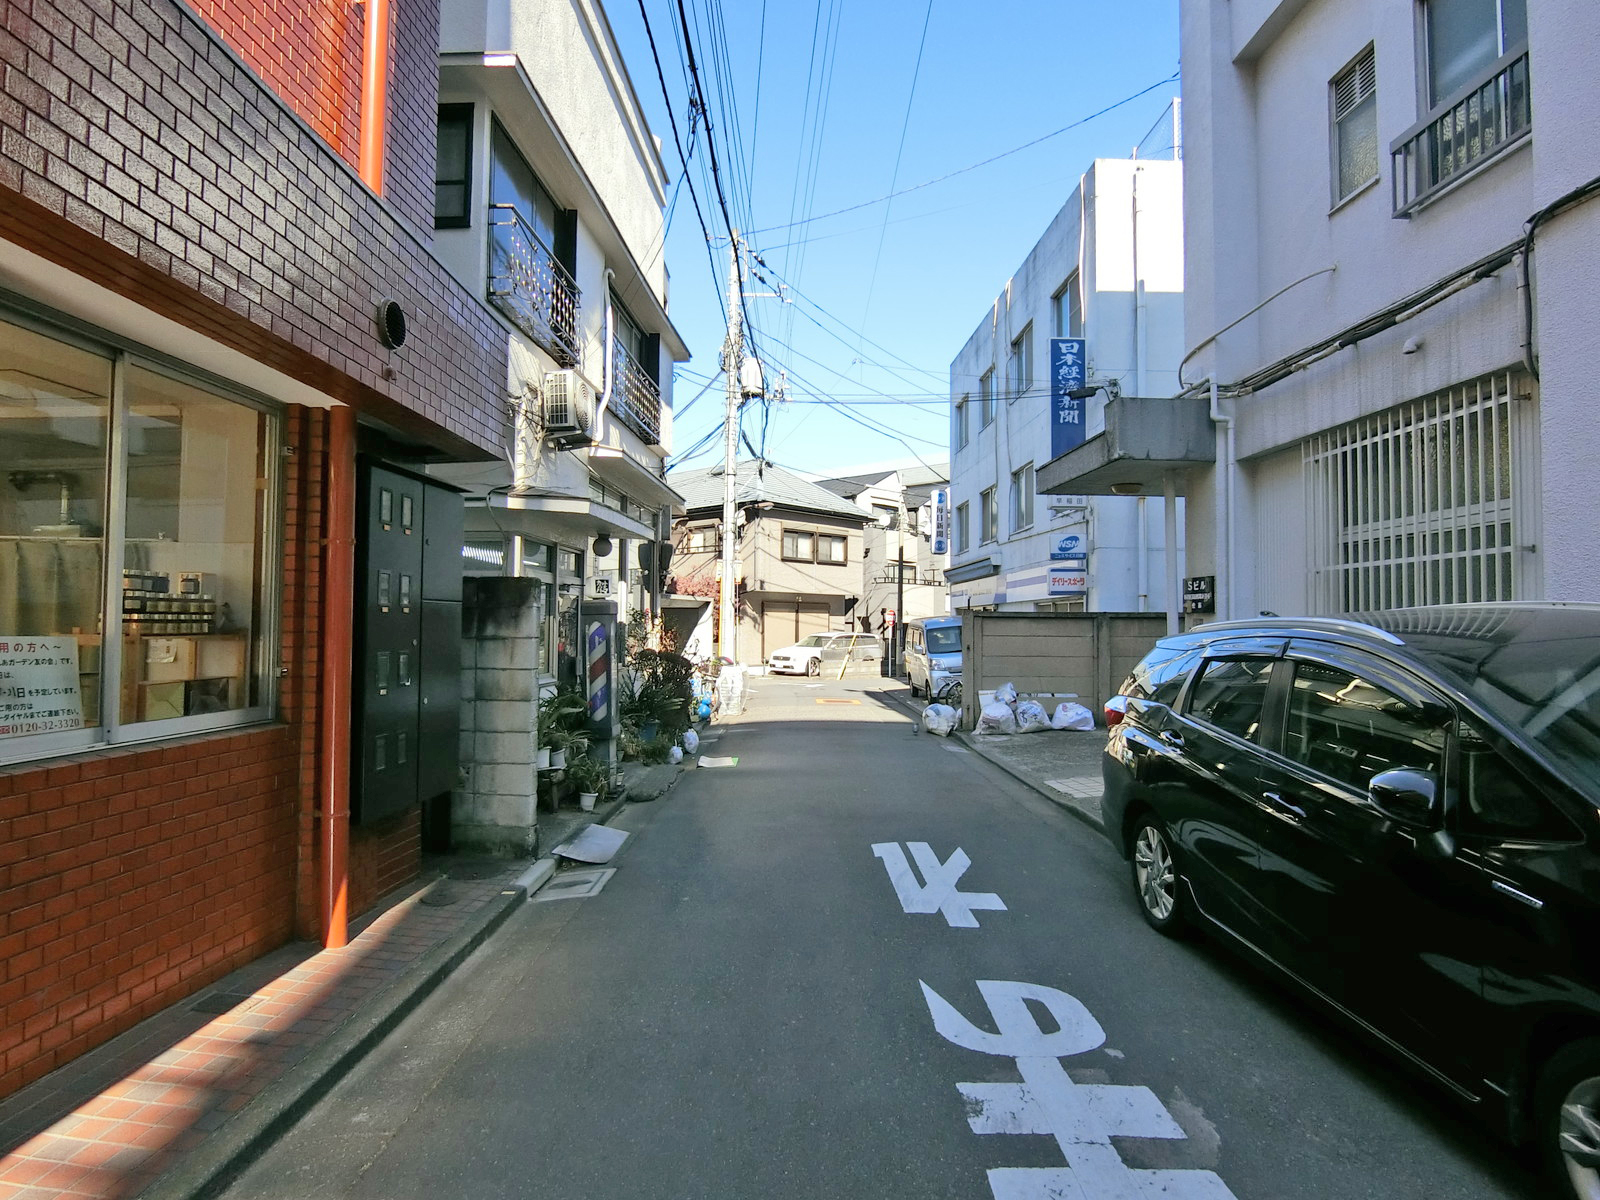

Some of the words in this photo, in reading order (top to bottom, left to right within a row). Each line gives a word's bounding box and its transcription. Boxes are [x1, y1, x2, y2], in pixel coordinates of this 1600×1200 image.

[936, 505, 944, 538] 毎日新聞
[1187, 580, 1206, 591] Sビル
[11, 718, 80, 734] 0120-32-3320
